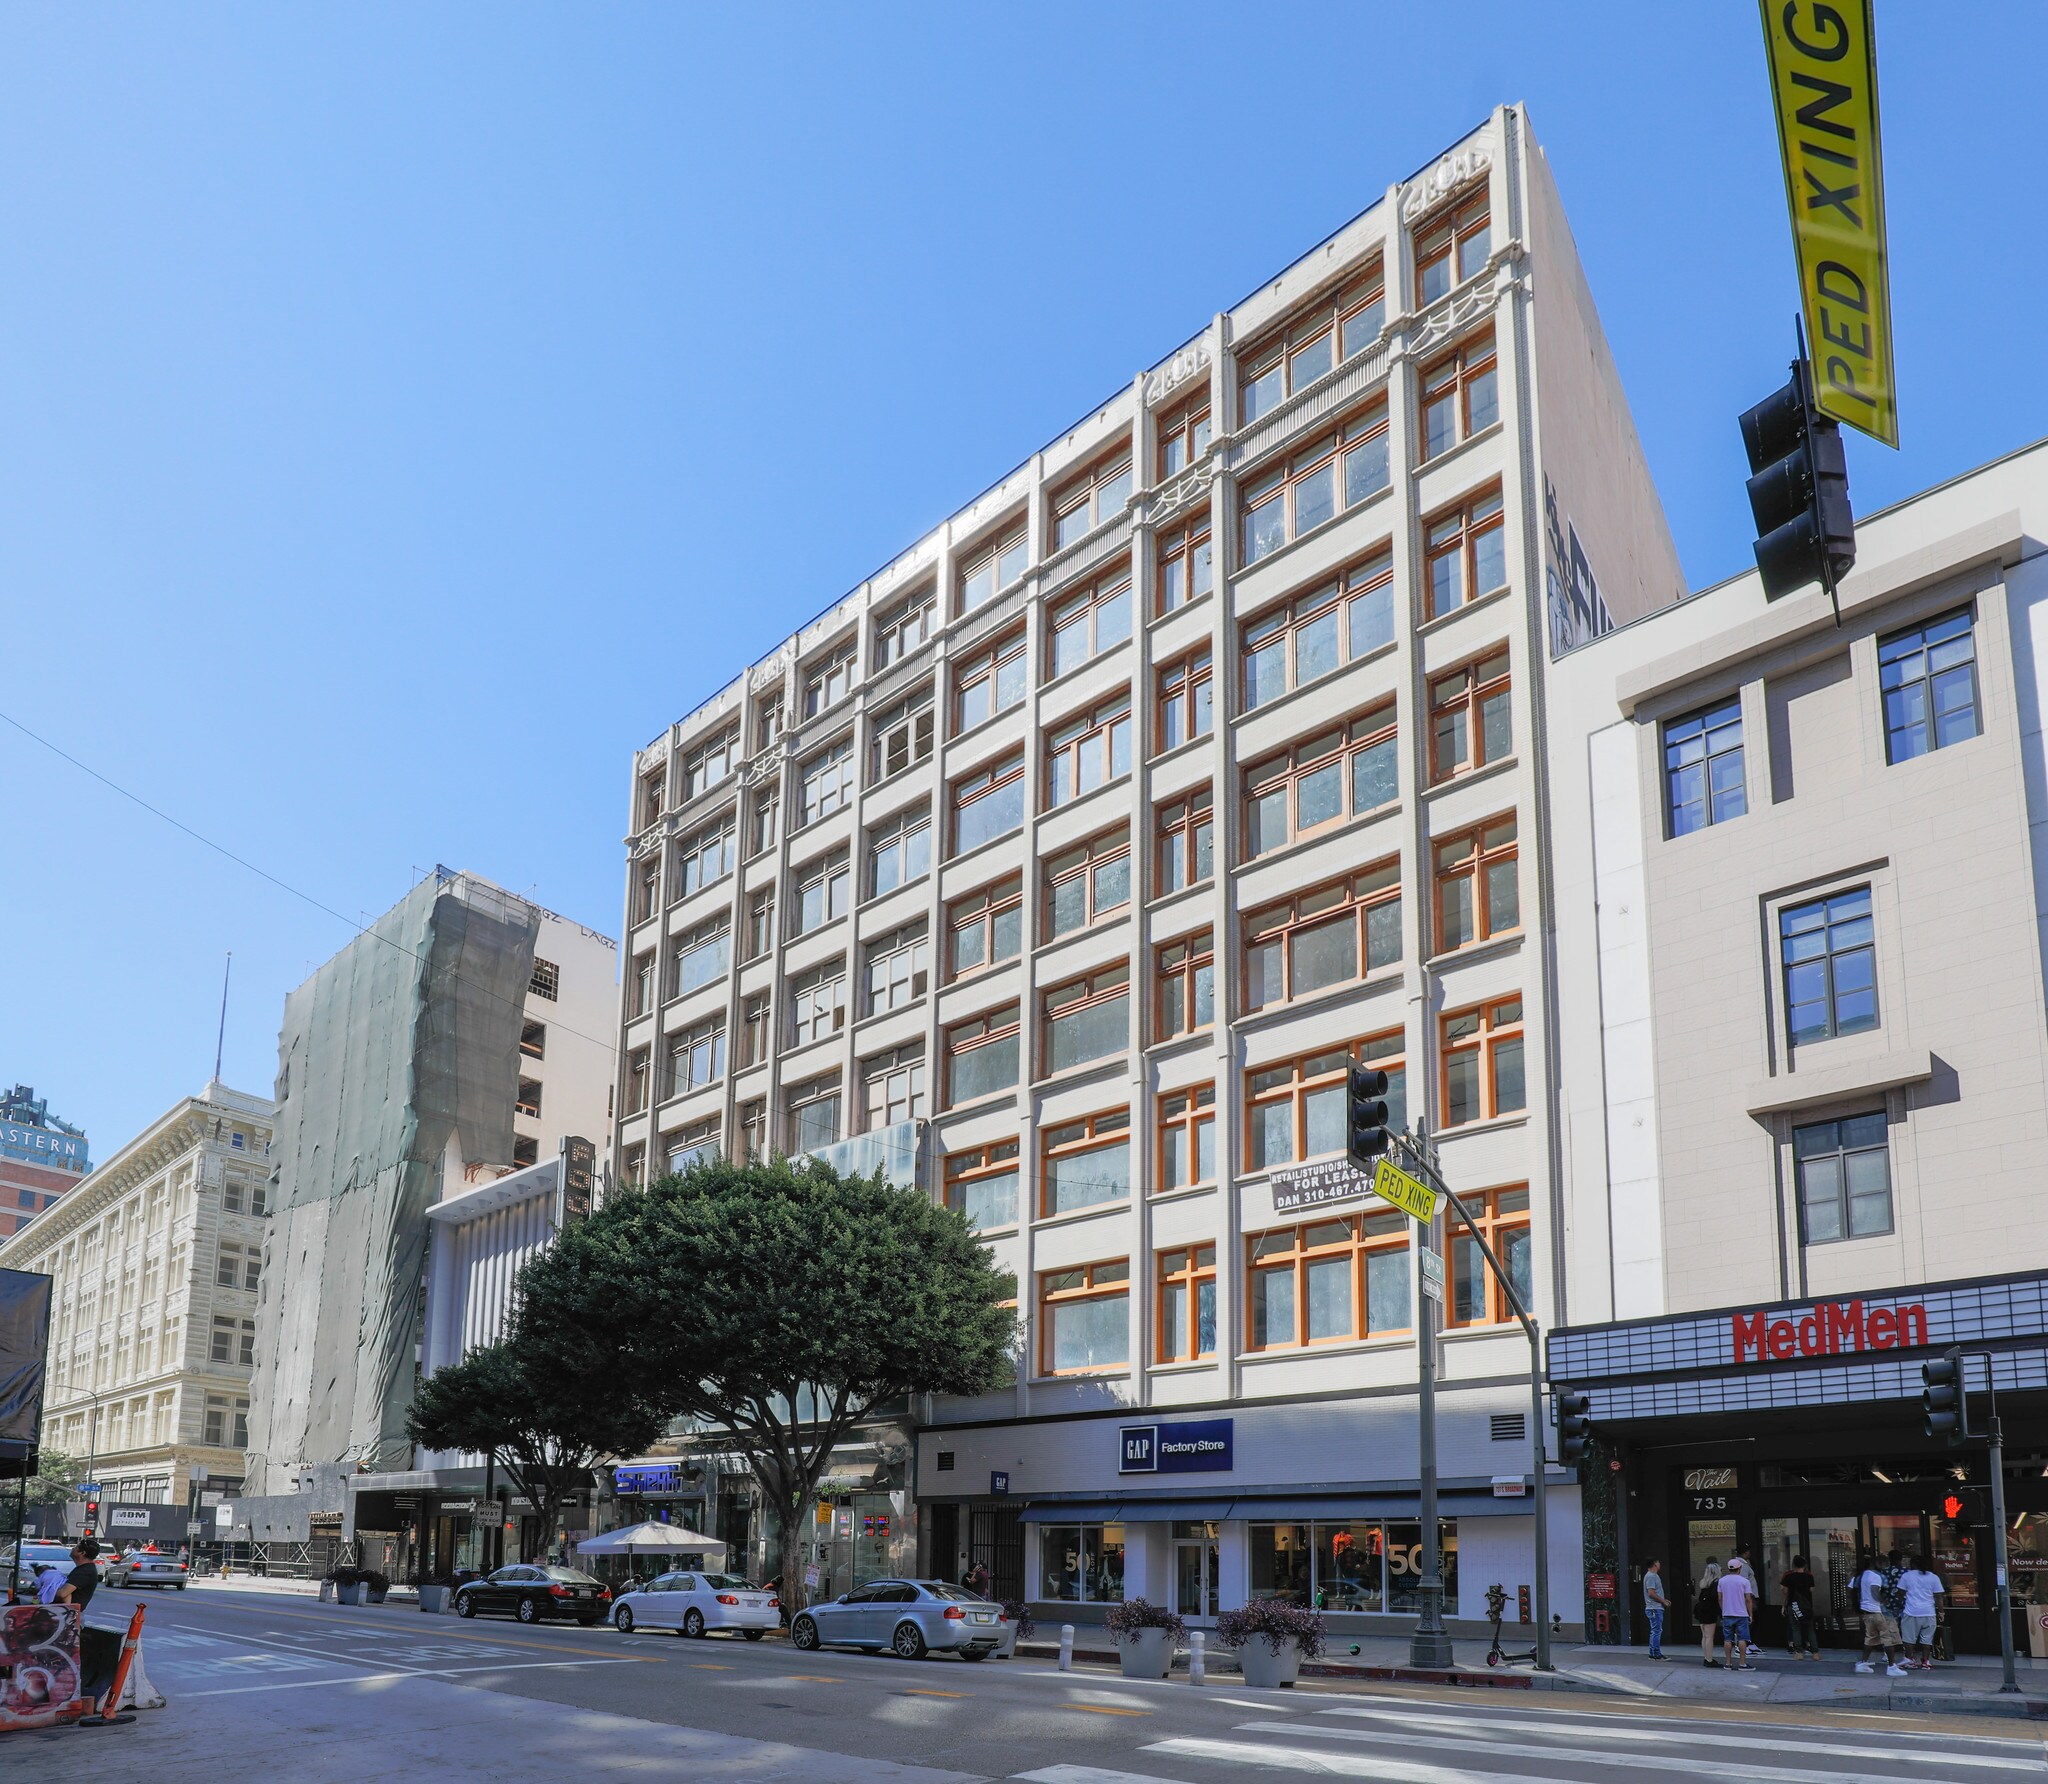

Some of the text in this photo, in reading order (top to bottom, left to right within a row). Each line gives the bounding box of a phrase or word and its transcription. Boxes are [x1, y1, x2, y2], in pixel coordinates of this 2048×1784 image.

[1782, 0, 1877, 408] PED XING
[1277, 1179, 1375, 1208] DAN 310-467.470
[1294, 1176, 1320, 1191] FOR
[1379, 1168, 1431, 1216] PED XING
[1732, 1299, 1928, 1364] MedMen
[1127, 1440, 1225, 1459] GAP Factory Store
[1685, 1468, 1732, 1491] Vail
[1693, 1497, 1727, 1510] 735
[1065, 1552, 1090, 1572] 50
[2012, 1558, 2048, 1566] Now de
